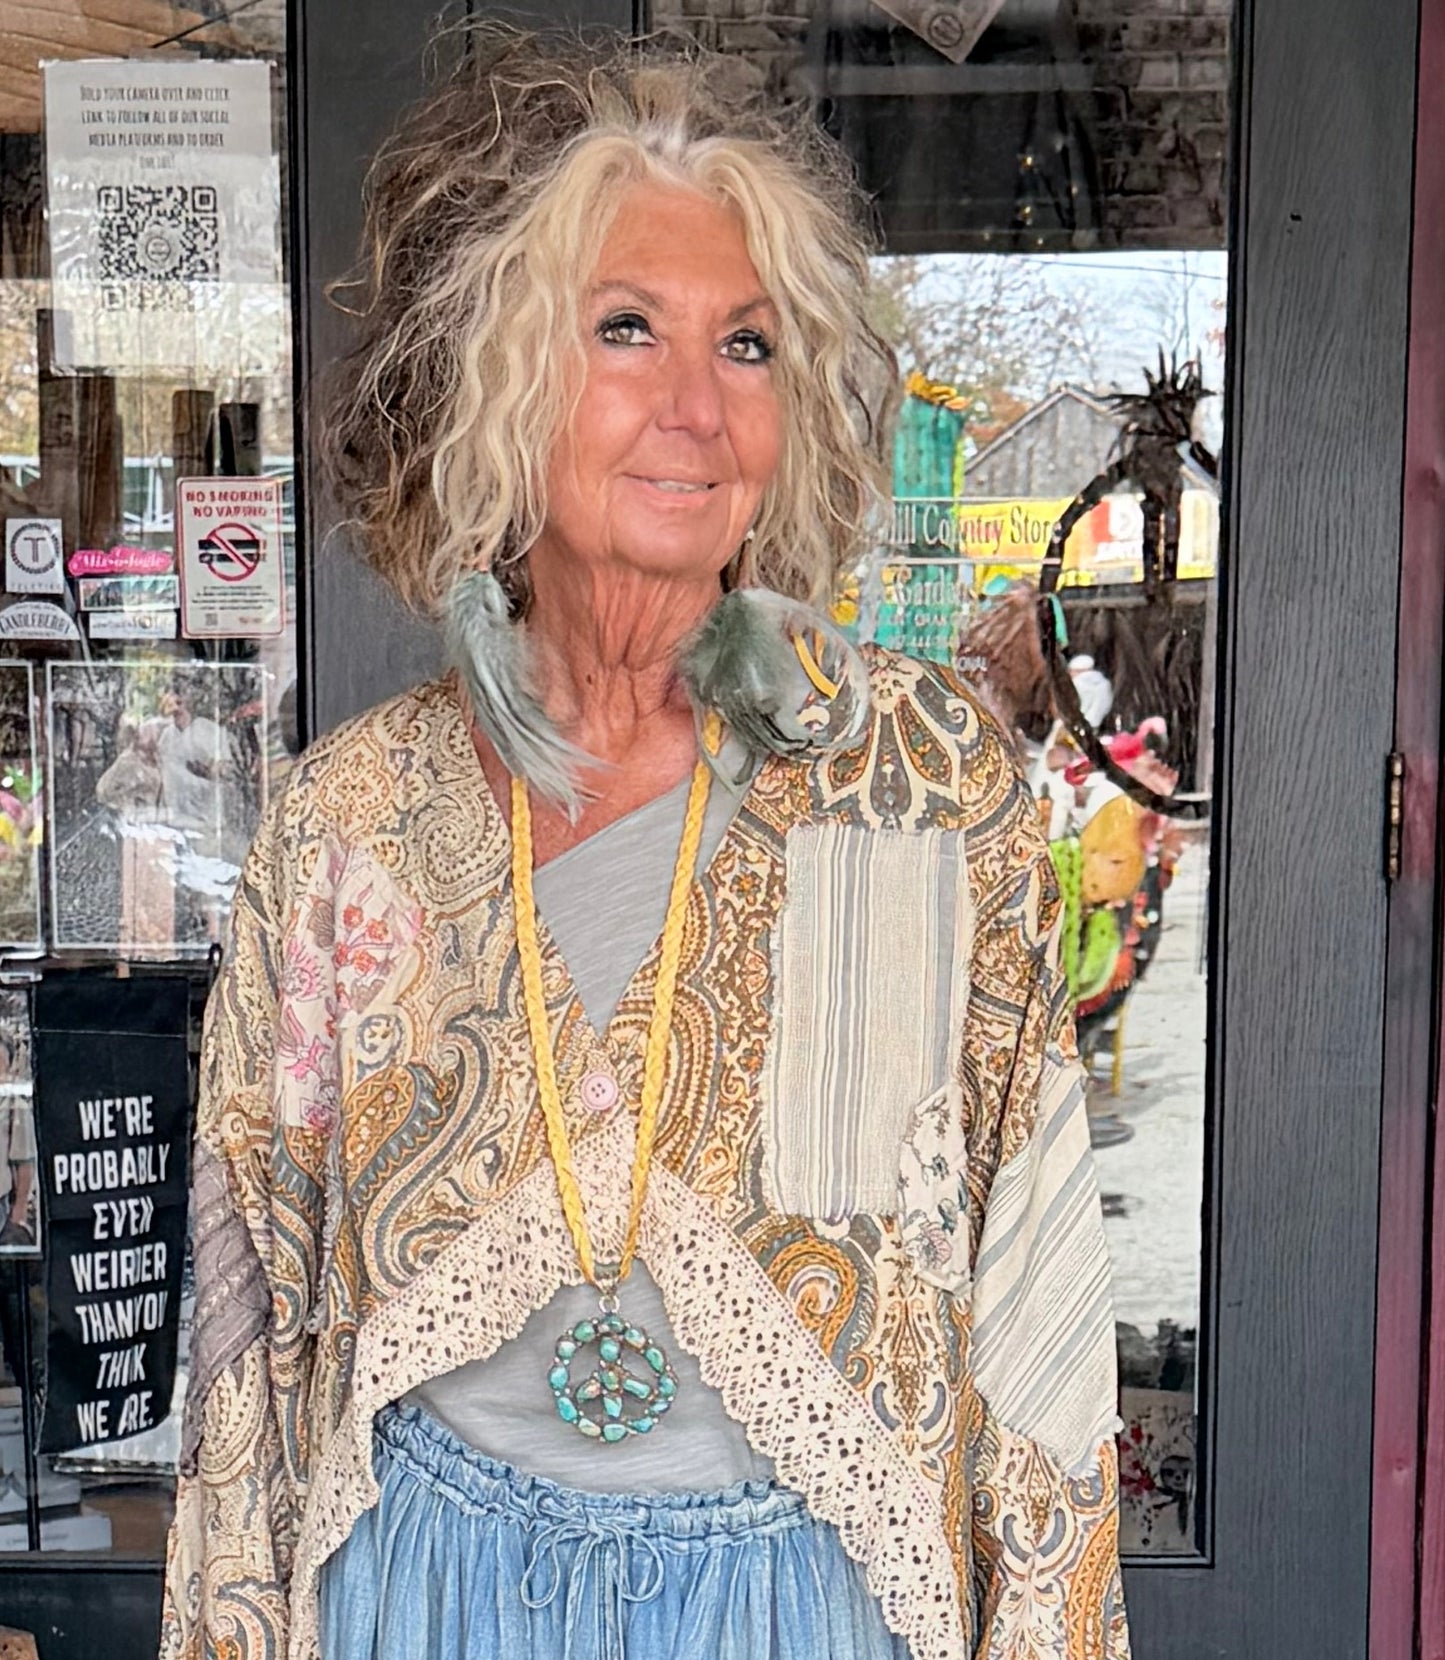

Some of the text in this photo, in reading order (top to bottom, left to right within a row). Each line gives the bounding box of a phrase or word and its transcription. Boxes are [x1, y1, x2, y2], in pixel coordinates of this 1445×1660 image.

[104, 86, 125, 101] YOUR
[127, 86, 159, 101] CAMERA
[162, 86, 183, 101] OVER
[186, 86, 202, 101] AND
[205, 86, 230, 101] CLICK
[81, 110, 229, 124] LINK TO FOLLOW ALL OF OUR SOCIAL
[89, 133, 224, 147] MEDIA PLATFORMS AND TO ORDER
[186, 490, 273, 502] NO SMOKING
[193, 506, 267, 518] NO VAPING
[923, 503, 1004, 555] Country
[79, 1095, 154, 1141] WE'RE
[53, 1142, 171, 1195] PROBABLY
[93, 1195, 154, 1240] EVEN
[70, 1241, 167, 1293] WEIRDER
[77, 1400, 110, 1443] WE
